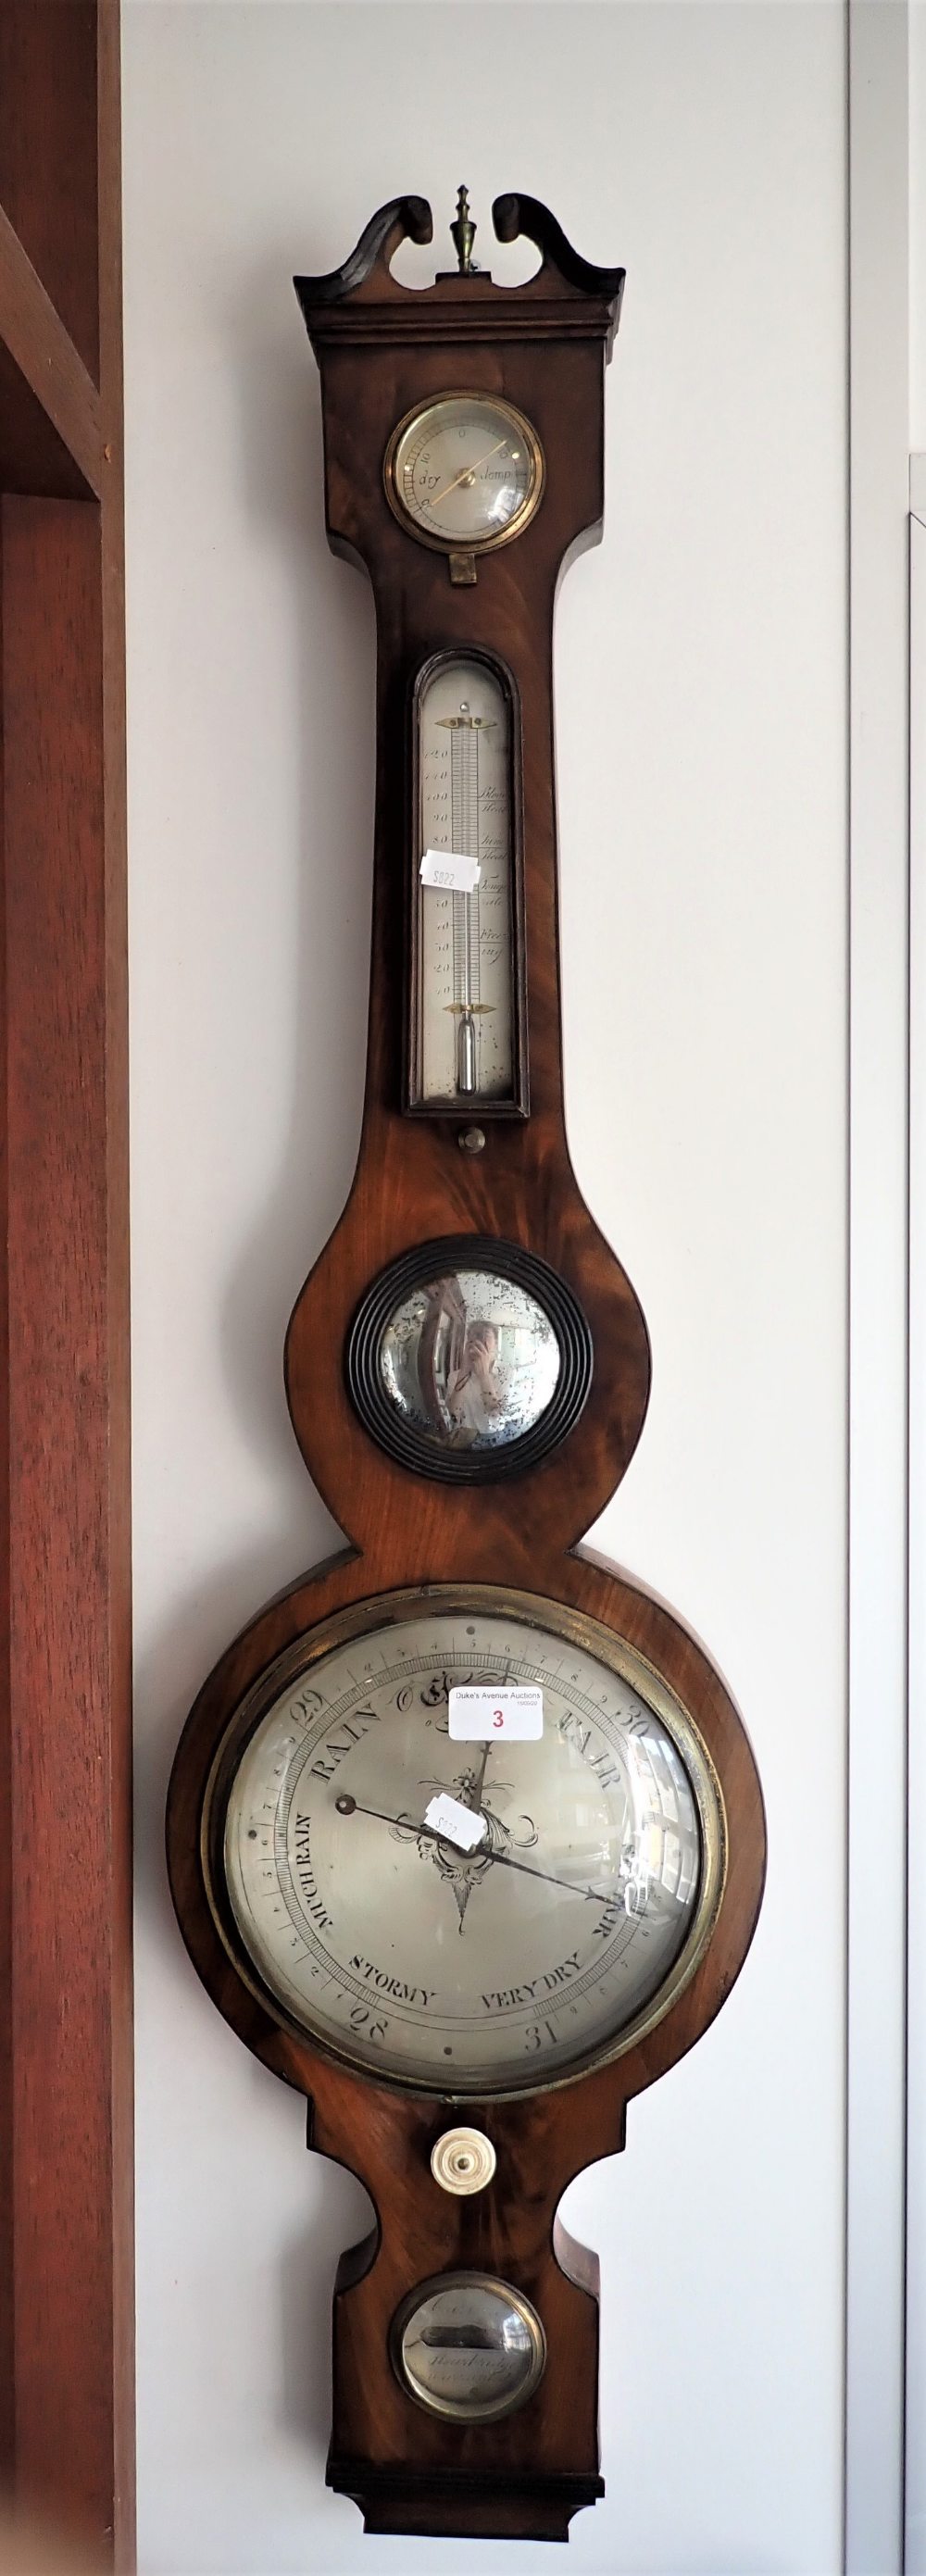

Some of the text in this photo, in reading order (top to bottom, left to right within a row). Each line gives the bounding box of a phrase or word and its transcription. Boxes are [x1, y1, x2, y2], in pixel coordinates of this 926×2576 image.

[419, 469, 442, 490] dry
[290, 1688, 323, 1727] 29
[493, 1710, 504, 1728] 3
[614, 1705, 650, 1737] 30
[307, 1702, 381, 1788] RAIN
[557, 1707, 621, 1792] FAIR
[294, 1810, 334, 1930] MUCH RAIN
[592, 1893, 625, 1938] AIR
[348, 1954, 437, 2007] STORMY
[479, 1949, 583, 2009] VERY DRY
[349, 2007, 390, 2039] 28
[525, 2020, 557, 2052] 31
